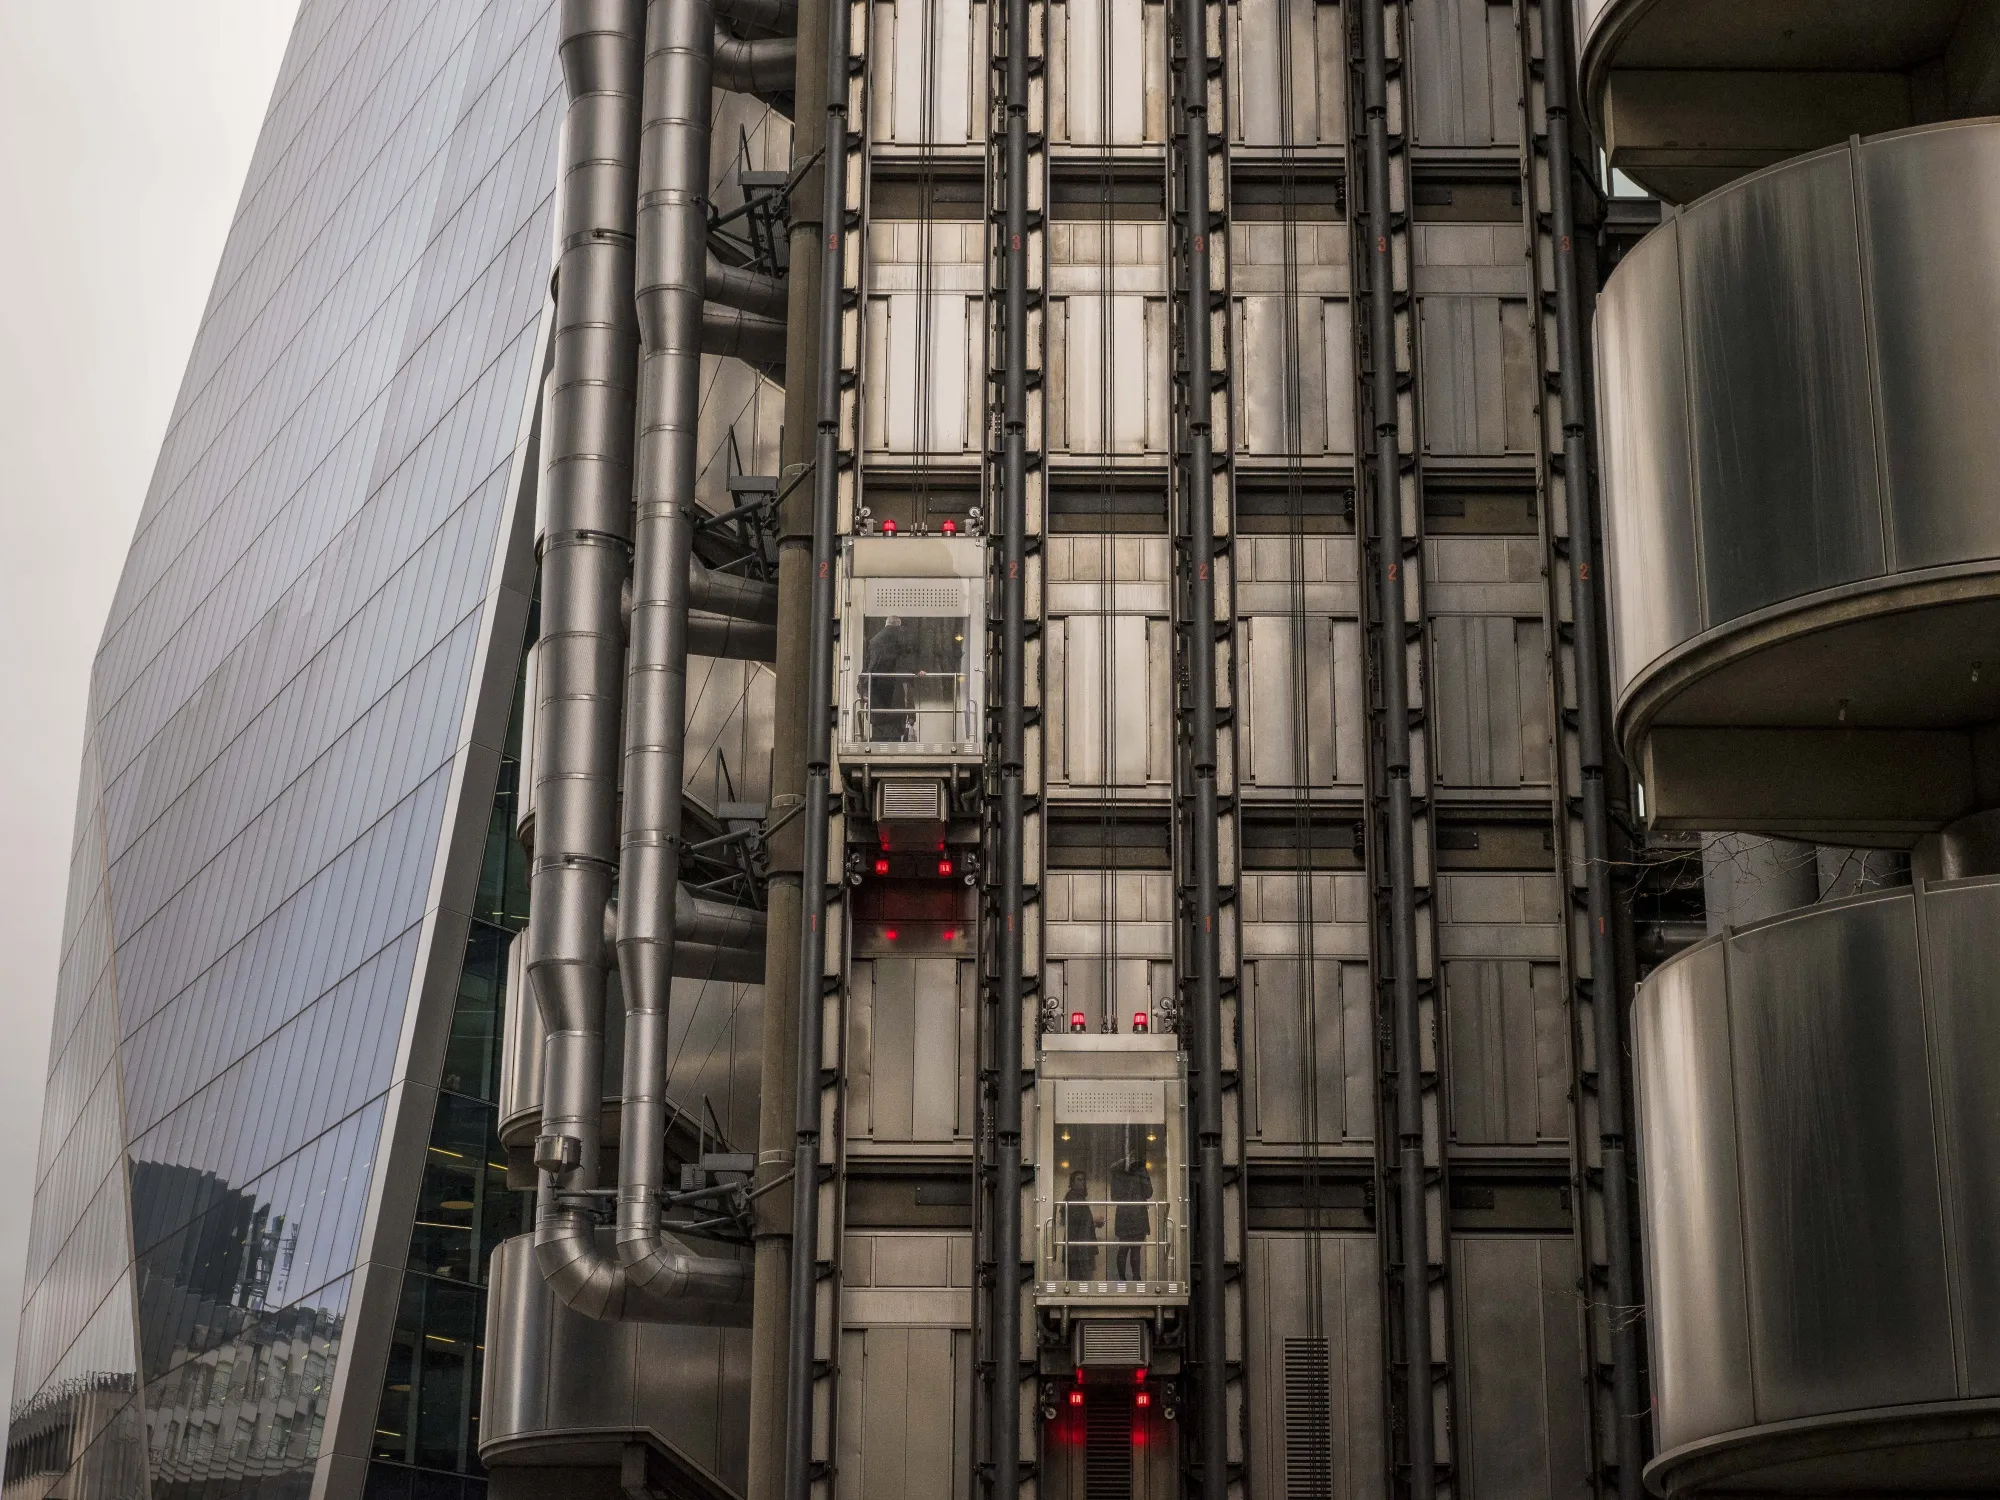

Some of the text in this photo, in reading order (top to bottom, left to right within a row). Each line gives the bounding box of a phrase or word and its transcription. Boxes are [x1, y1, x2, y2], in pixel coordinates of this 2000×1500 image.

[828, 234, 837, 251] 3
[1011, 235, 1021, 251] 3
[1194, 236, 1204, 253] 3
[1377, 236, 1387, 253] 3
[1561, 235, 1571, 251] 3
[819, 562, 829, 580] 2
[1009, 562, 1019, 580] 2
[1199, 563, 1209, 581] 2
[1388, 563, 1398, 581] 2
[1579, 563, 1589, 580] 2
[810, 914, 817, 933] 1
[1007, 914, 1014, 933] 1
[1204, 915, 1212, 933] 1
[1598, 916, 1606, 936] 1
